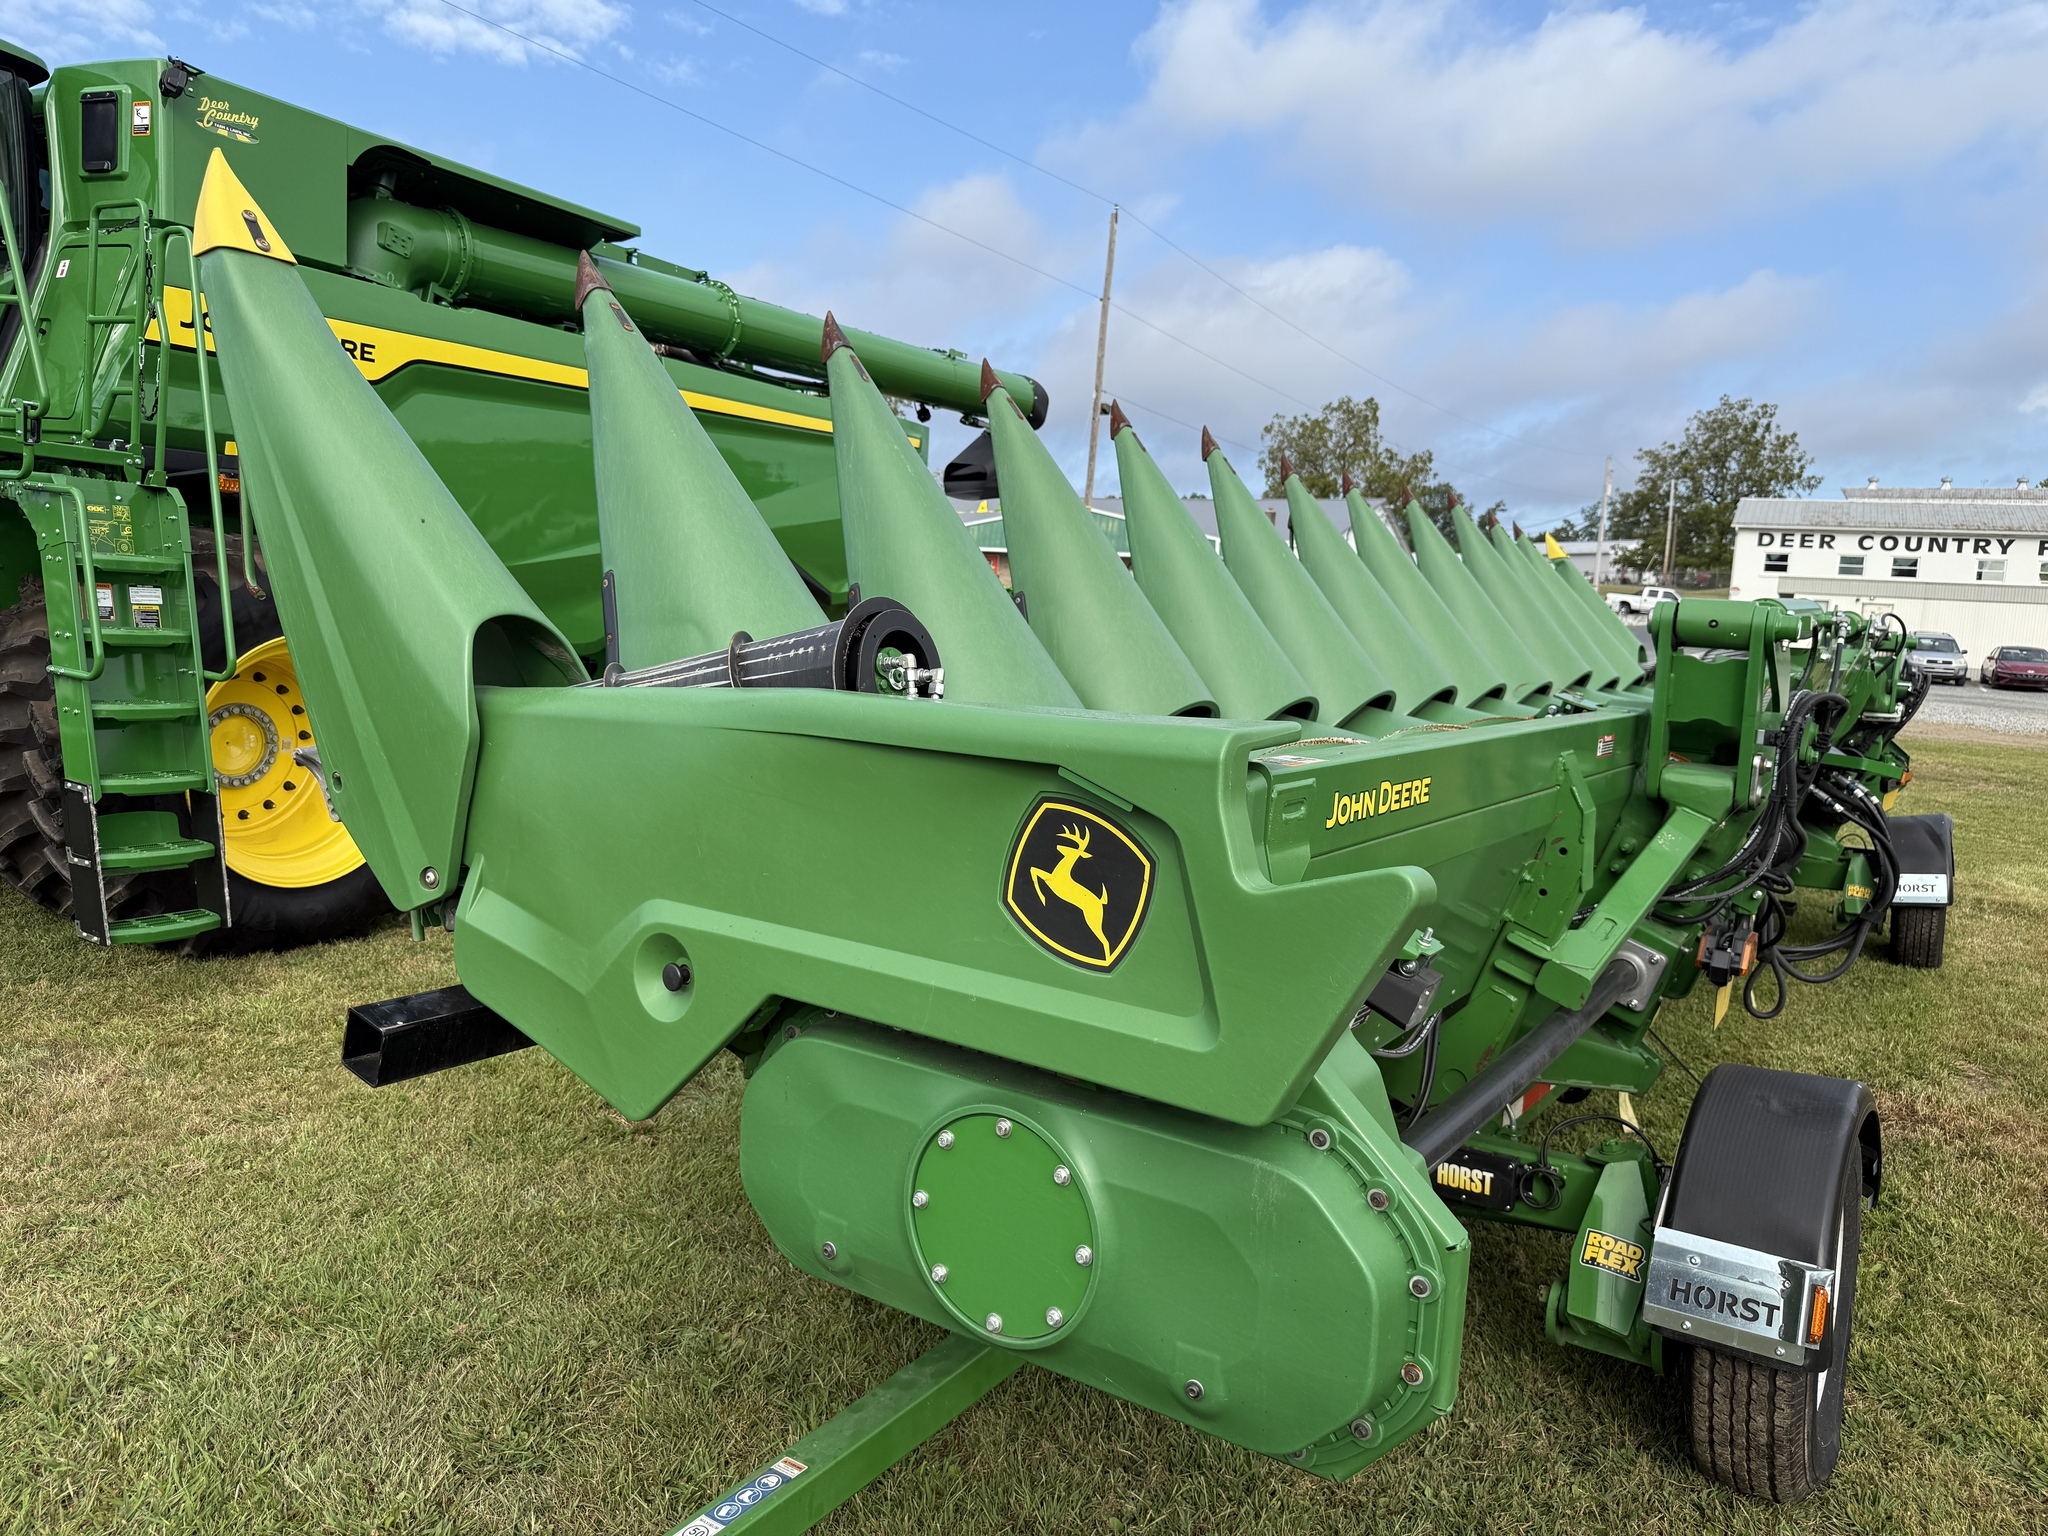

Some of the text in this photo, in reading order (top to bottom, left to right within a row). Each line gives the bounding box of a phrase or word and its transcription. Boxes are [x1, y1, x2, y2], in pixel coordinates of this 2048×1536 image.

[197, 97, 230, 111] Deer
[203, 109, 259, 129] Country
[1757, 532, 1836, 550] DEER
[1857, 535, 2017, 555] COUNTRY
[1325, 777, 1432, 829] JOHN DEERE
[1437, 1162, 1495, 1196] HORST
[1583, 1244, 1640, 1276] FLEX
[1587, 1232, 1643, 1260] ROAD
[1669, 1278, 1780, 1327] HORST
